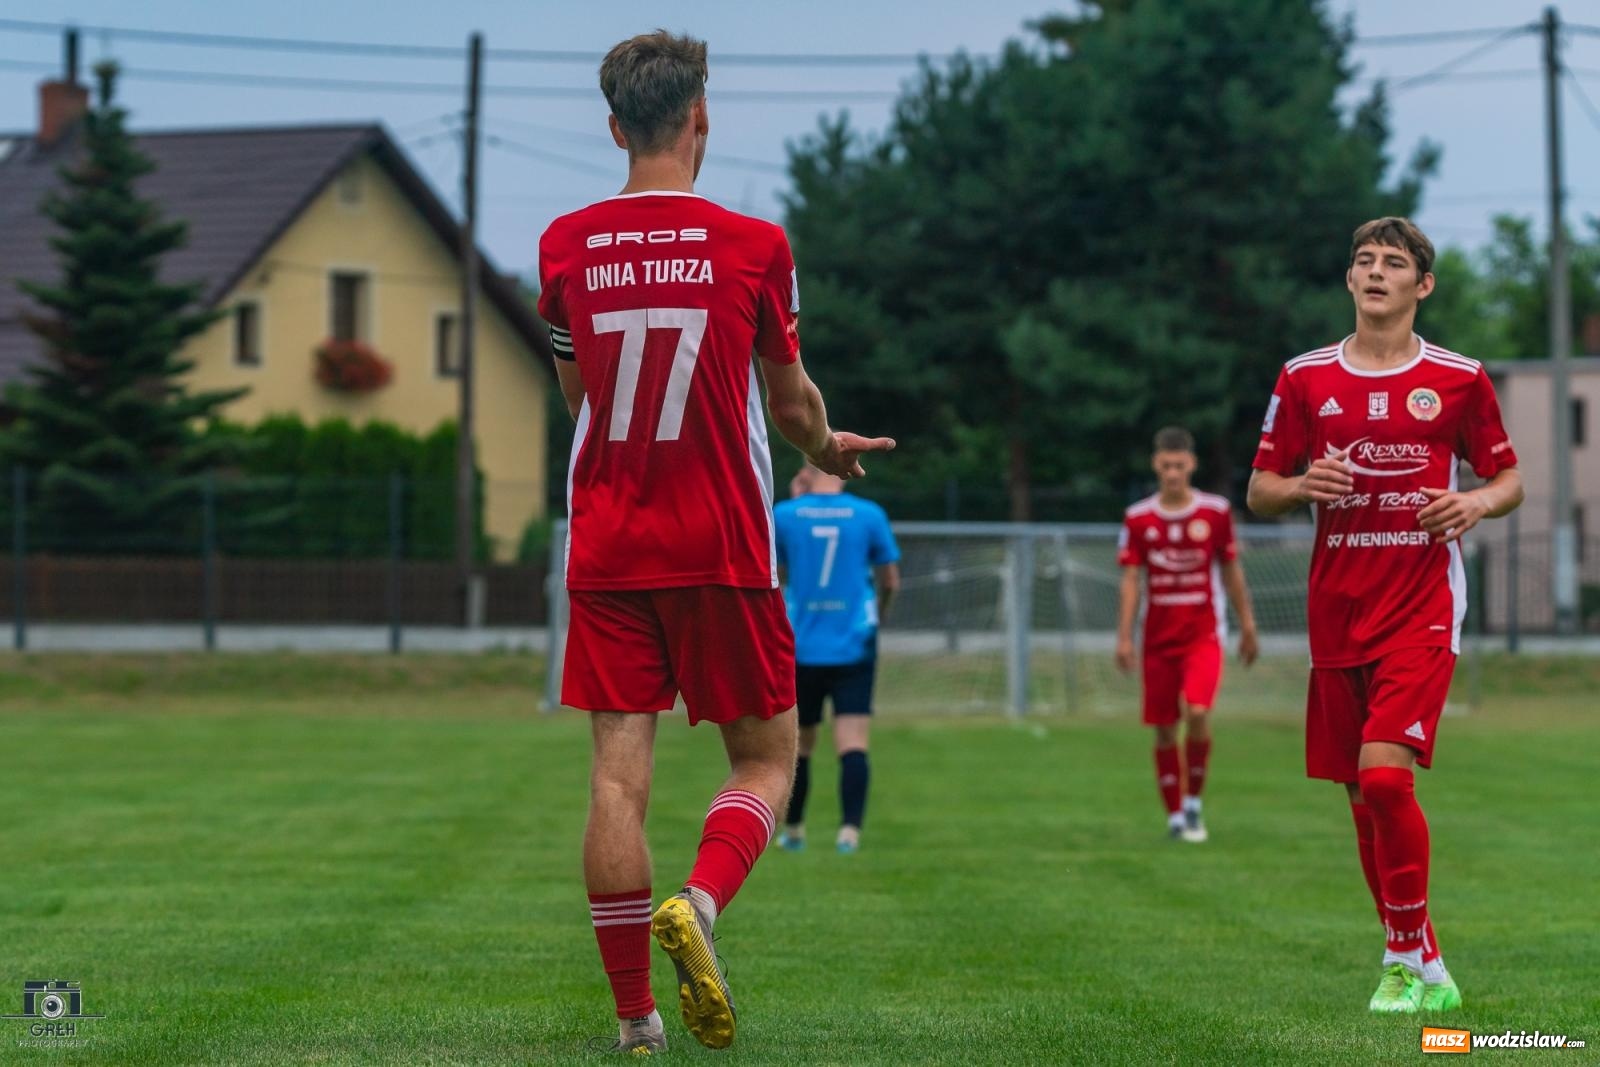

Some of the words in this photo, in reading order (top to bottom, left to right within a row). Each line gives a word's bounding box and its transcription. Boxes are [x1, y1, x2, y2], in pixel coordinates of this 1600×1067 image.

[586, 228, 708, 249] GROS
[585, 262, 636, 291] UNIA
[642, 259, 714, 285] TURZA
[592, 308, 708, 441] 77
[1378, 492, 1429, 506] TRANS
[1346, 531, 1429, 548] WENINGER
[811, 526, 839, 588] 7
